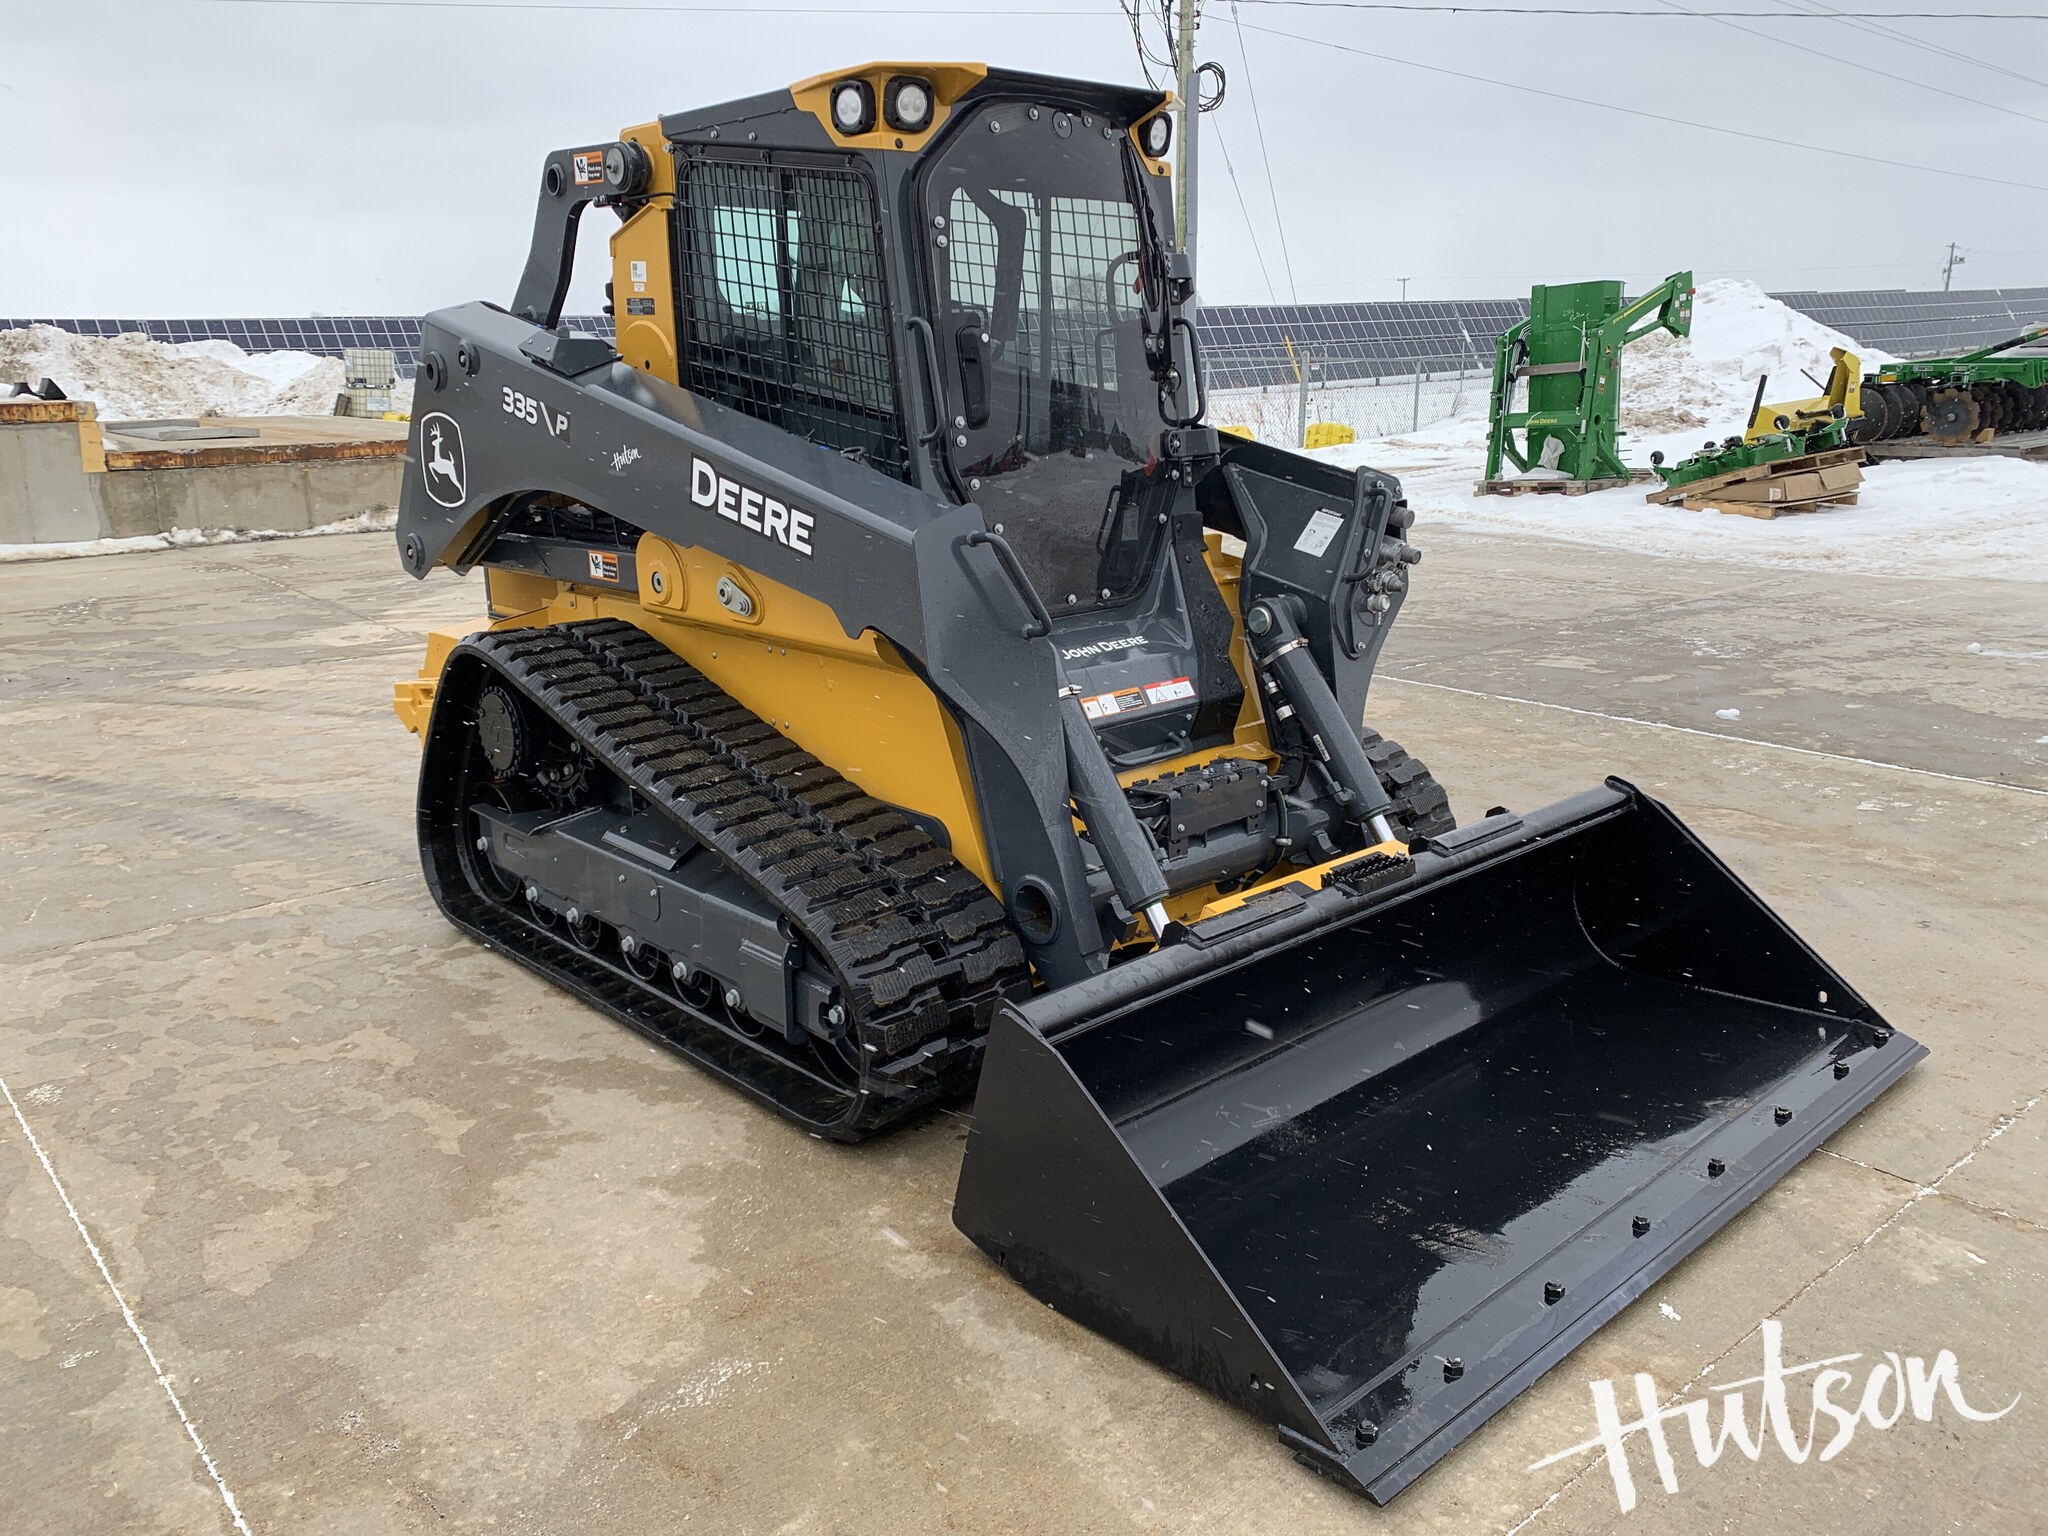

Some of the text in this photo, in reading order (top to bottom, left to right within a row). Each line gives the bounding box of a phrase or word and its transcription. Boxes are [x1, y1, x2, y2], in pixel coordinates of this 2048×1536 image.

[610, 444, 643, 472] Hutson
[691, 457, 815, 556] DEERE
[1061, 635, 1149, 661] JOHN DEERE
